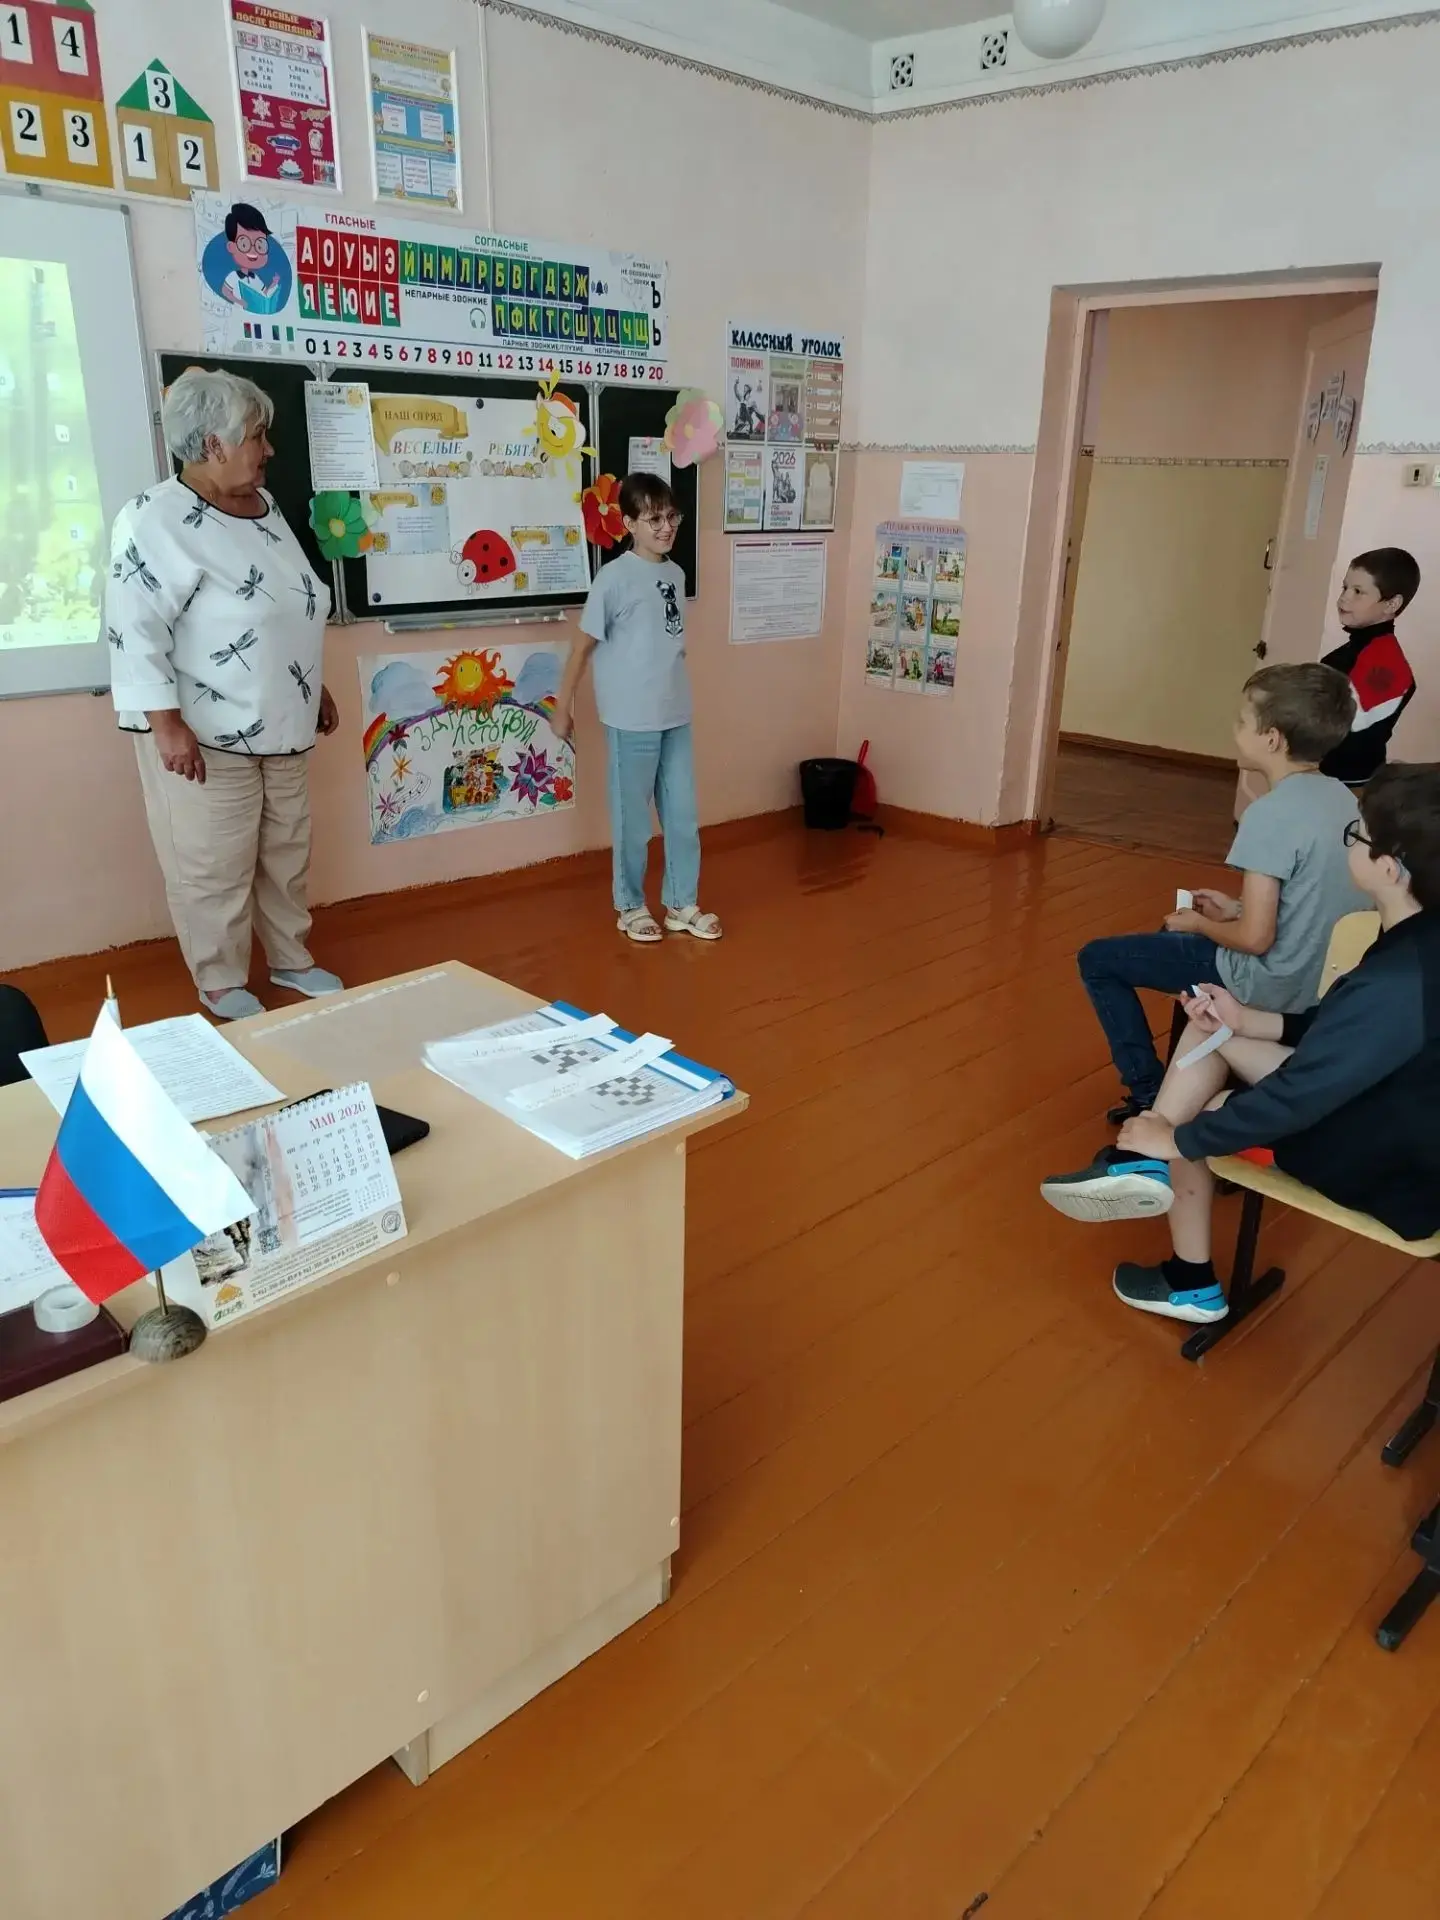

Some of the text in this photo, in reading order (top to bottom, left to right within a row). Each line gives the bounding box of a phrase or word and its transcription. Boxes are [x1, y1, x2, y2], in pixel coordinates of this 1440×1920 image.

[235, 11, 267, 28] ПОСЛЕ
[254, 5, 300, 24] ГЛАСНЫЕ
[7, 13, 81, 58] 1 4
[153, 77, 171, 109] 3
[17, 107, 90, 147] 2 3
[133, 132, 201, 171] 1 2
[324, 213, 377, 231] ГЛАСНЫЕ
[474, 235, 529, 252] СОГЛАСНЫЕ
[301, 236, 395, 275] А О У Ы Э
[404, 242, 588, 298] Й Н М Л Р Б В Г Д З Ж
[302, 282, 396, 319] Я Ё Ю И Е
[405, 288, 489, 306] НЕПАРНЫЕ ЗВОНКИЕ
[650, 280, 661, 309] Ъ
[495, 304, 649, 344] П Ф К Т С Ш Х Ц Ч Щ
[652, 318, 662, 346] Ь
[502, 339, 529, 348] ПАРНЫЕ
[594, 347, 648, 358] НЕПАРНЫЕ ГЛУХИЕ
[731, 329, 841, 357] КЛАССНЫЙ УГОЛОК
[305, 338, 317, 355] 0
[322, 339, 331, 355] 1
[337, 340, 347, 357] 2
[352, 342, 362, 358] 3
[368, 343, 378, 359] 4
[383, 344, 393, 360] 5
[399, 346, 408, 361] 6
[414, 347, 422, 362] 7
[427, 348, 437, 363] 8
[442, 349, 451, 364] 9
[457, 350, 473, 366] 10
[478, 352, 493, 367] 11
[497, 353, 514, 369] 12
[518, 355, 534, 371] 13
[538, 357, 554, 373] 14
[558, 359, 573, 374] 15
[577, 360, 592, 375] 16
[596, 362, 610, 376] 17
[614, 363, 628, 378] 18
[631, 365, 645, 379] 19
[648, 366, 664, 380] 20
[730, 356, 764, 370] ПОМНИМ!
[384, 410, 444, 422] НАШ ОТРЯД
[393, 440, 538, 457] ВЕСЕЛЫЕ РЕБЯТА
[773, 451, 796, 465] 2026
[338, 1101, 366, 1120] 2026
